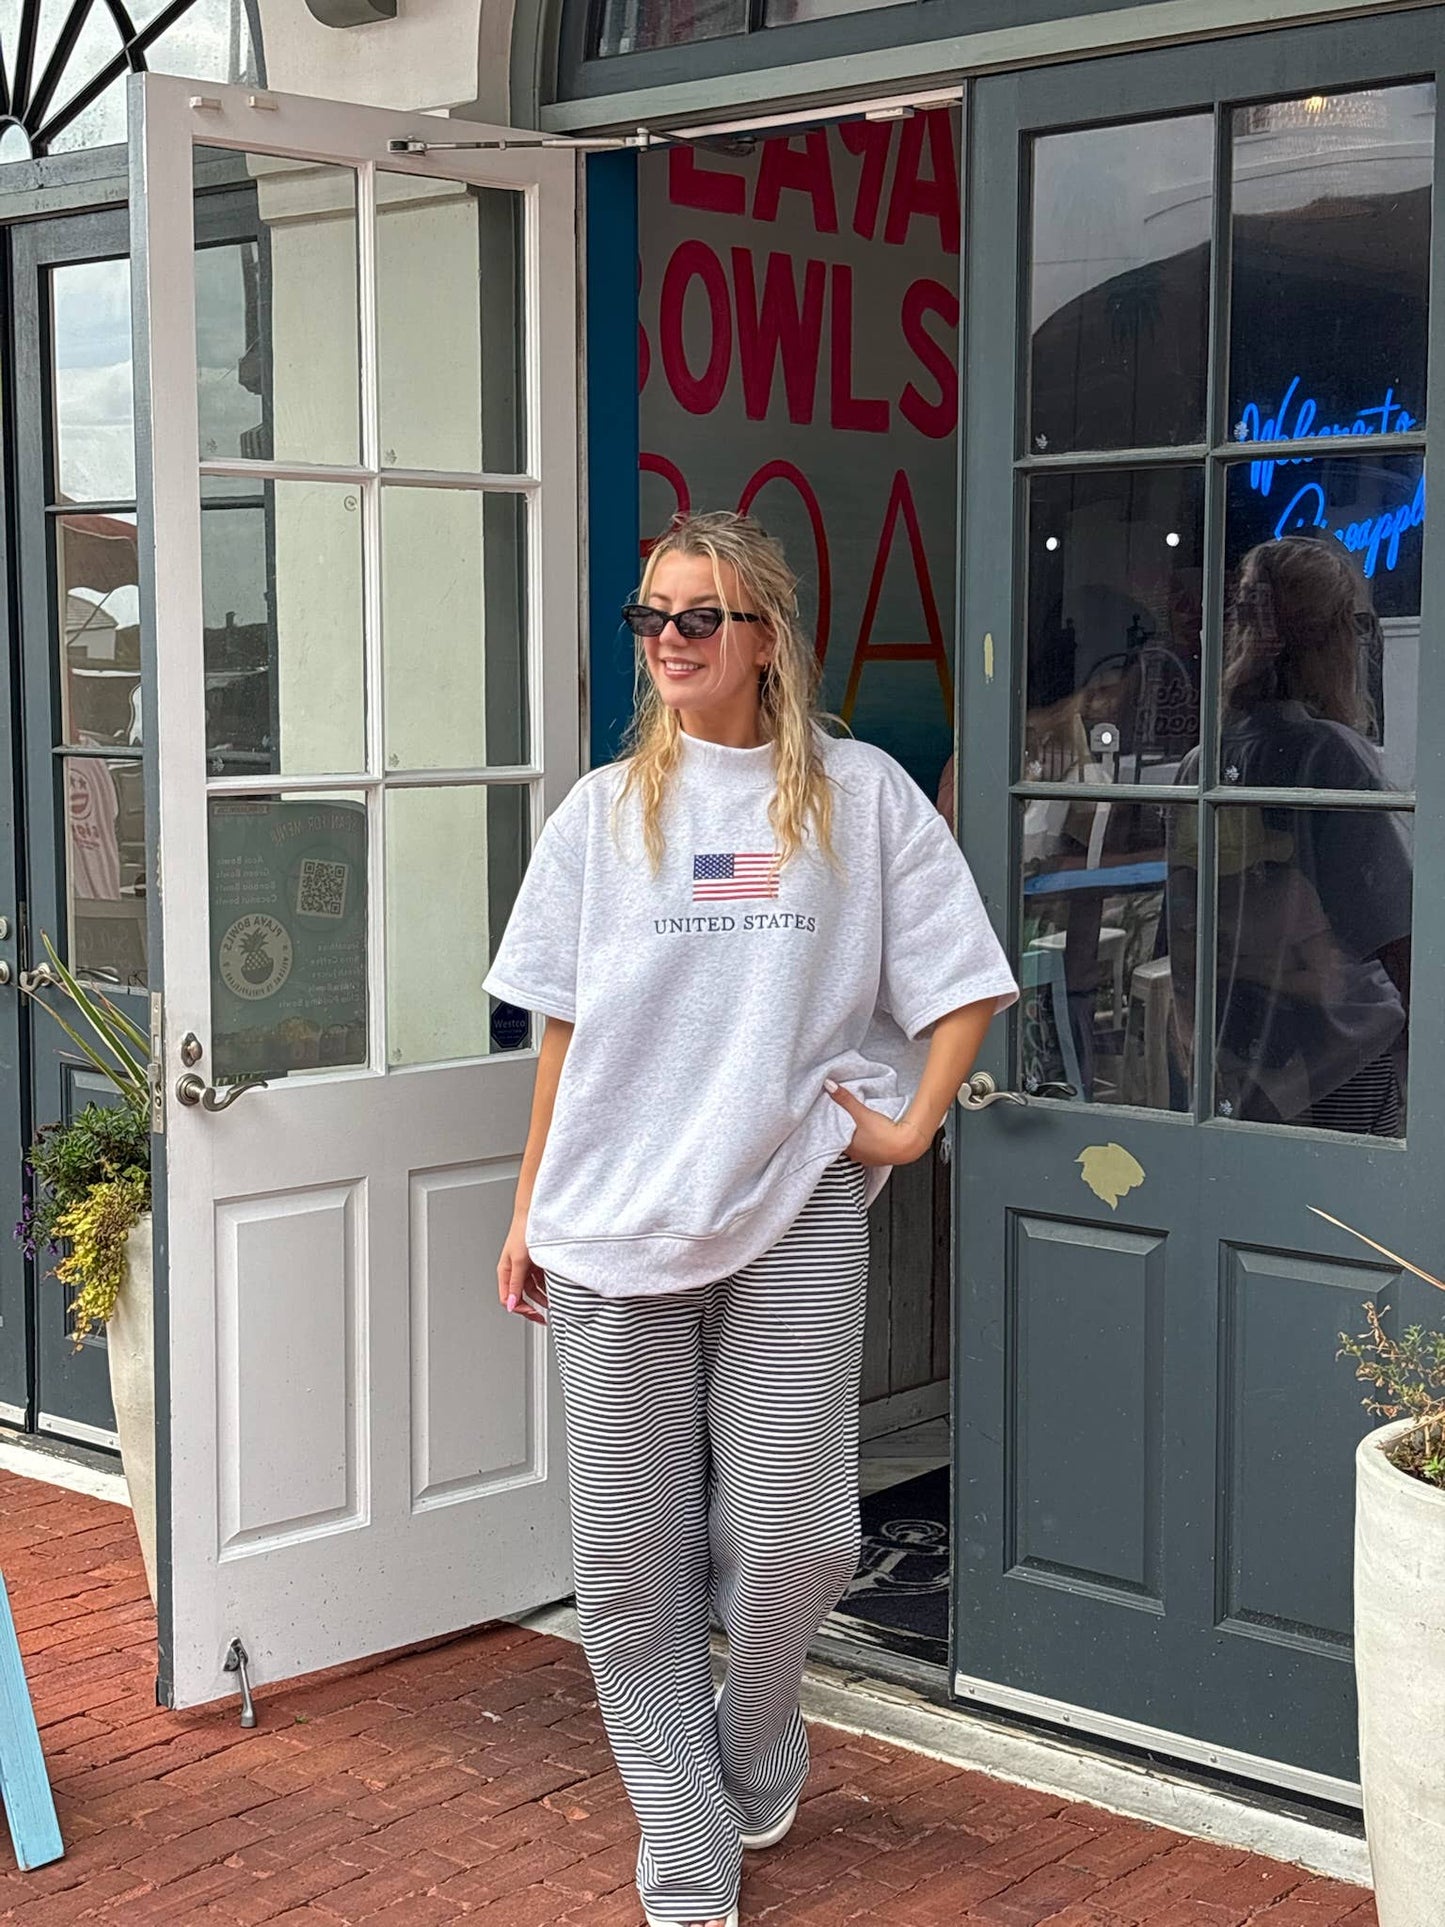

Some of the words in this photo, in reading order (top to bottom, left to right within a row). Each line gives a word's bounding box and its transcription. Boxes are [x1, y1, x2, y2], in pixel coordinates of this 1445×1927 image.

[638, 239, 960, 439] OWLS
[654, 916, 736, 935] UNITED
[743, 913, 817, 933] STATES
